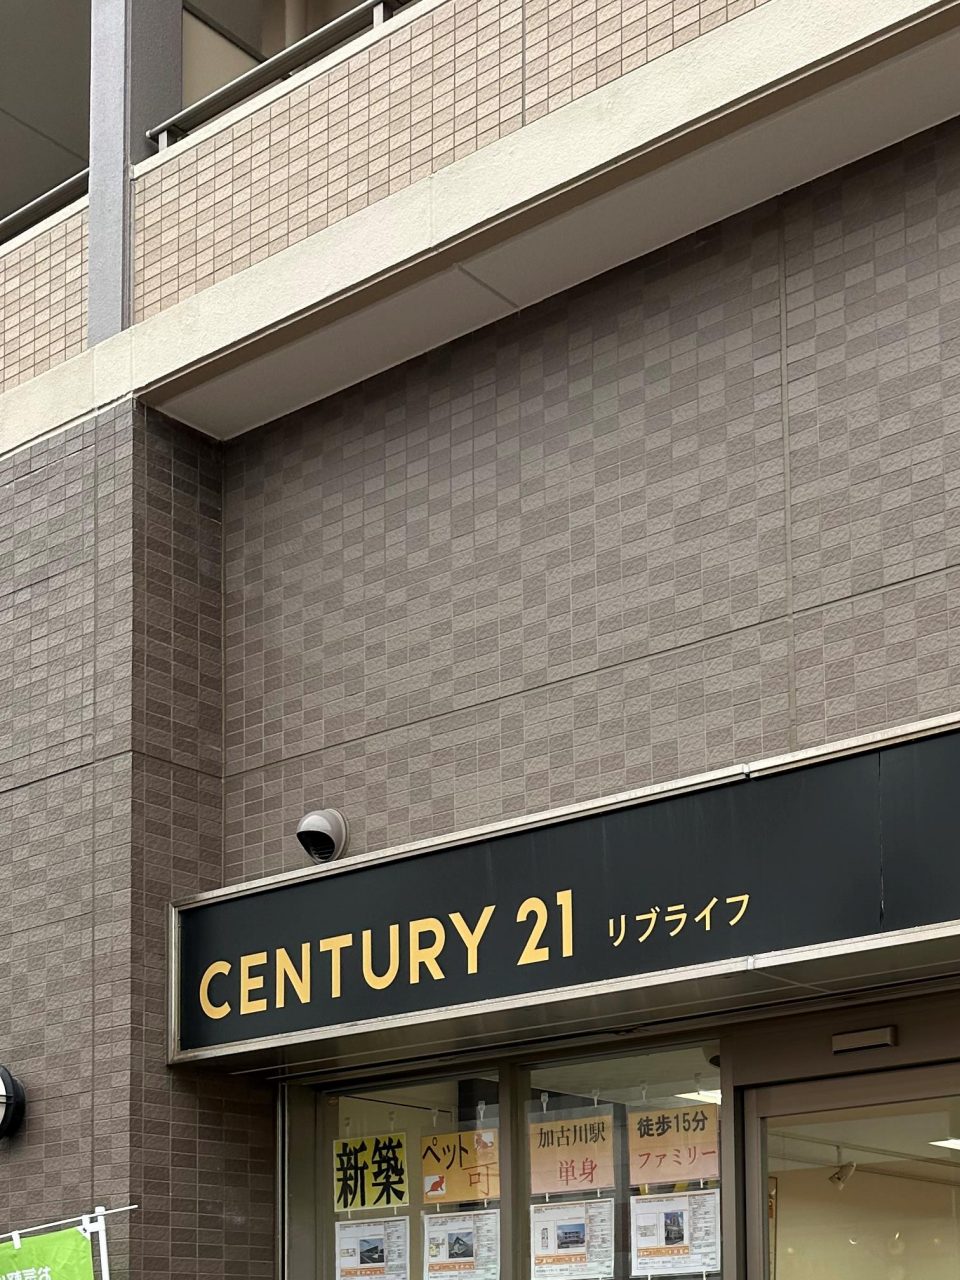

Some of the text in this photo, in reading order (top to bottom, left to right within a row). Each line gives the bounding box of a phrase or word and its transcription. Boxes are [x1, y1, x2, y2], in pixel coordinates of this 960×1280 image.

[607, 892, 752, 948] リブライフ
[199, 889, 573, 1020] CENTURY 21
[538, 1121, 606, 1149] 加古川駅
[637, 1109, 708, 1138] 徒歩15分
[421, 1134, 469, 1171] ペット
[637, 1145, 717, 1170] ファミリー
[336, 1137, 406, 1209] 新築
[557, 1157, 598, 1186] 単身
